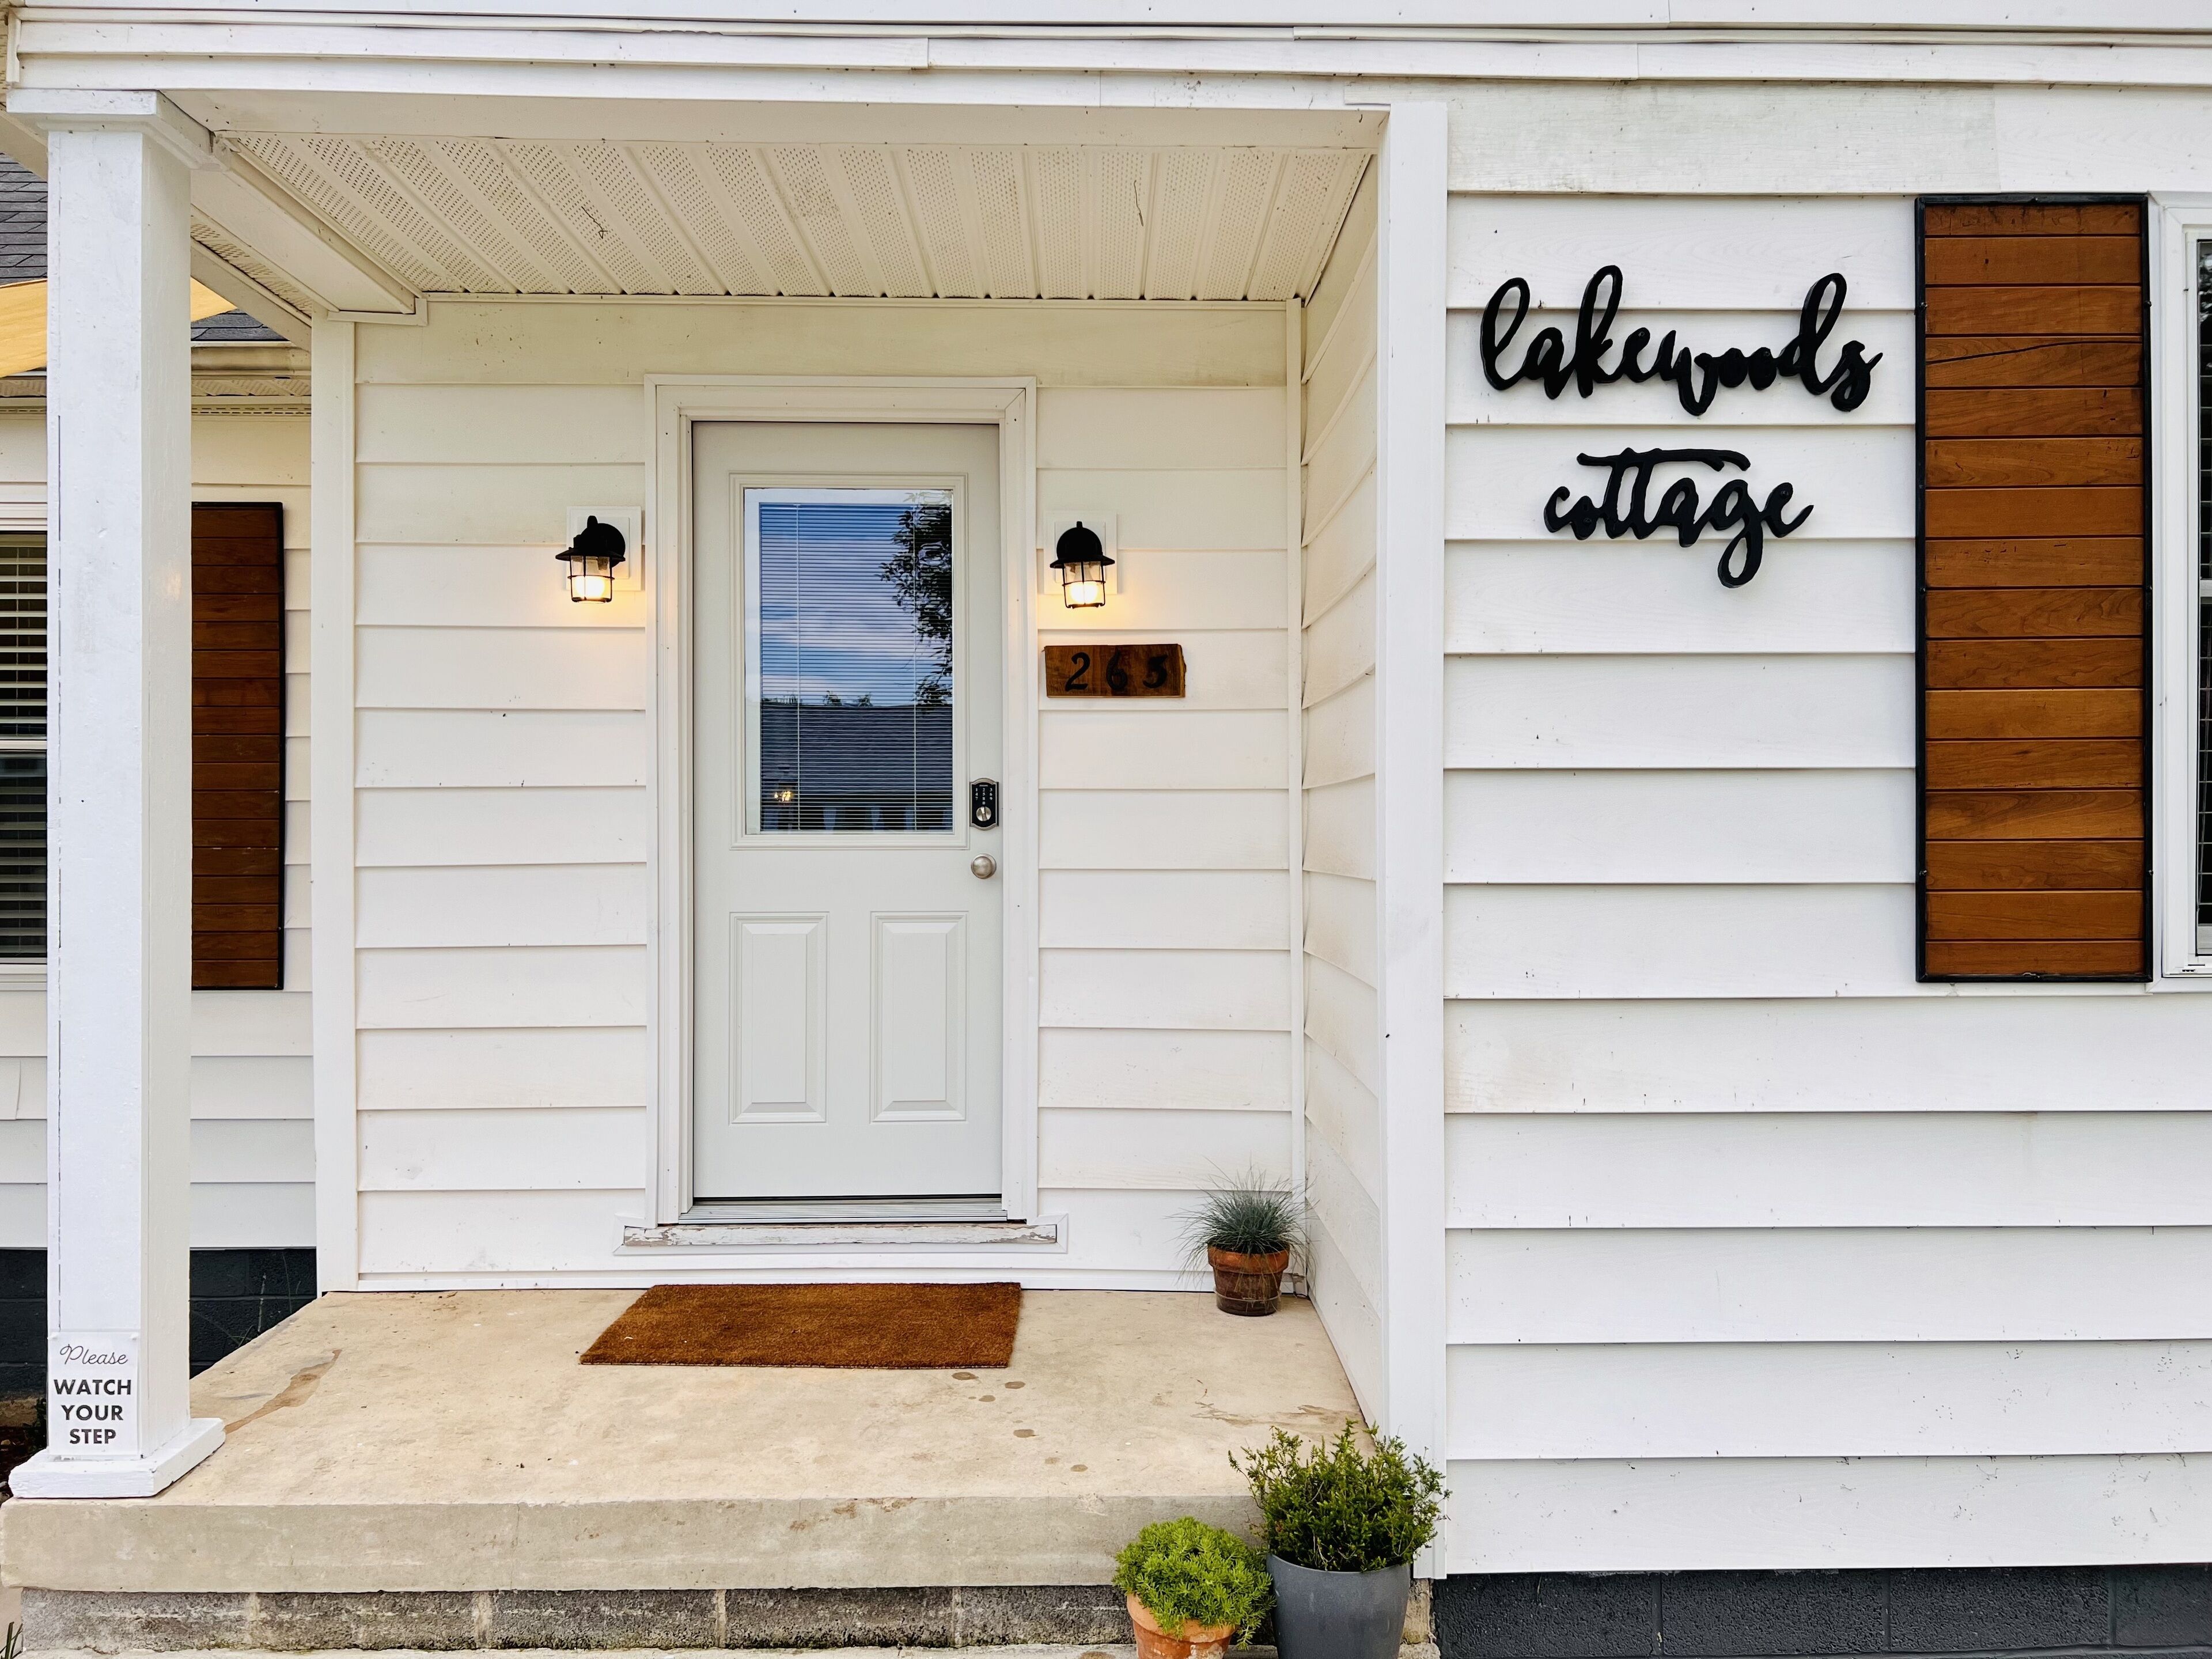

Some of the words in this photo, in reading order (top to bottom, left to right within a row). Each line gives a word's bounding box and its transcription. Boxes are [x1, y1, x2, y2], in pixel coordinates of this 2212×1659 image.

[1480, 265, 1883, 416] lakewoods
[1543, 448, 1814, 588] cottage
[1065, 651, 1168, 692] 265
[60, 1344, 128, 1365] Please
[54, 1379, 131, 1395] WATCH
[61, 1404, 124, 1421] YOUR
[69, 1429, 116, 1444] STEP
